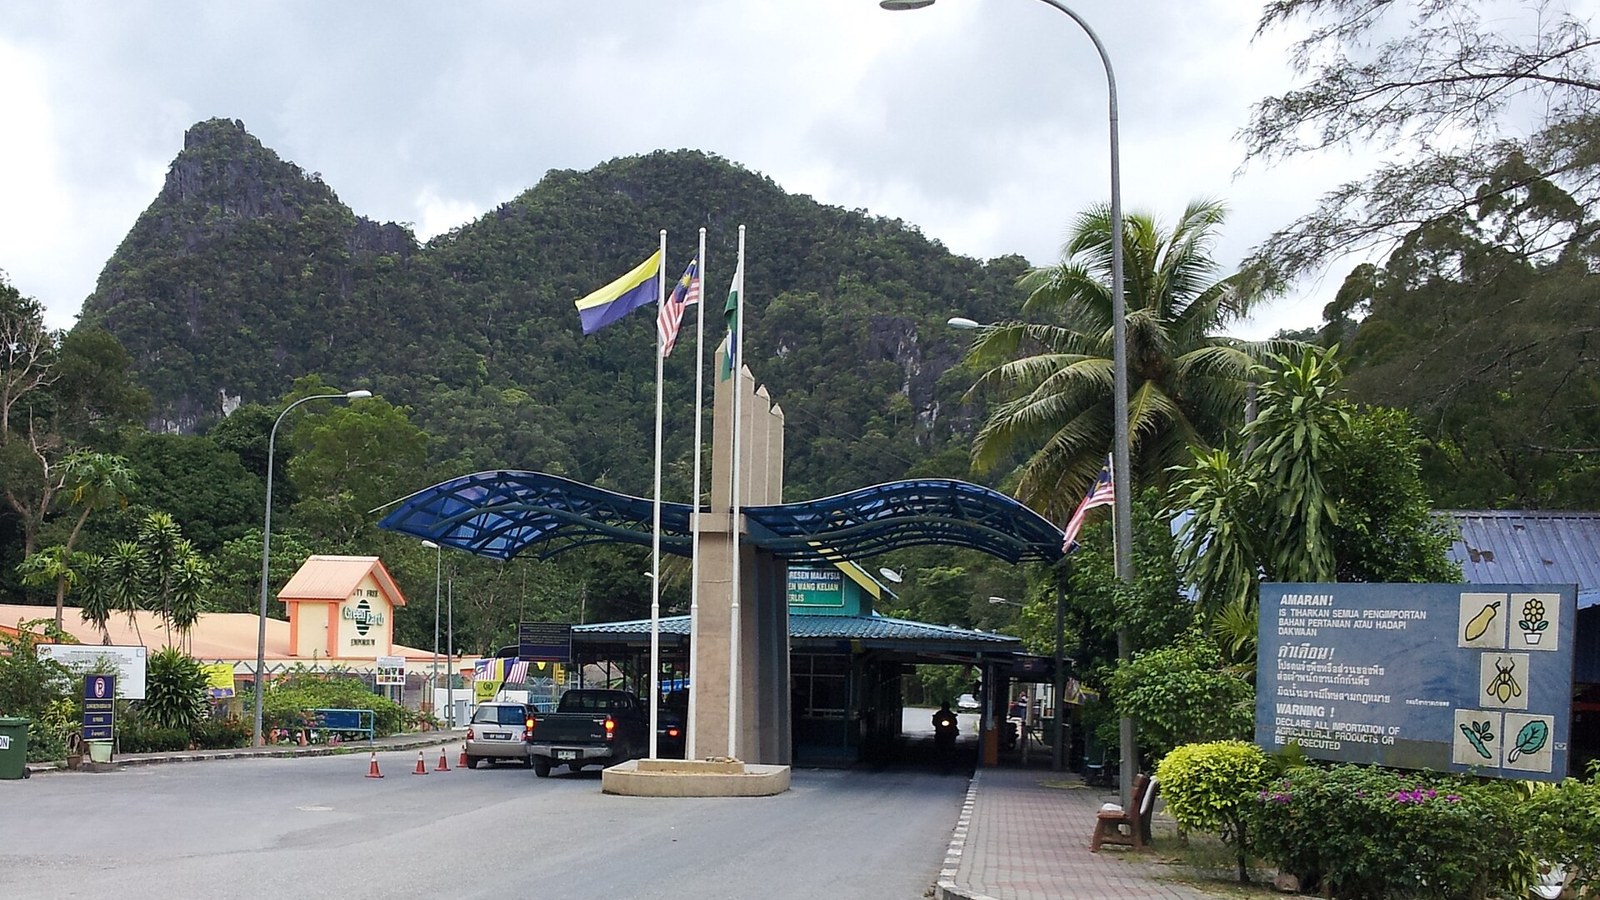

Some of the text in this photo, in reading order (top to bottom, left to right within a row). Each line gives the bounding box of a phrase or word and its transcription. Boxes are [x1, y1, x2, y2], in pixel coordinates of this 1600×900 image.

[810, 571, 841, 580] MALAYSIA
[797, 582, 816, 591] WANG
[816, 583, 839, 591] KELIAN
[1280, 594, 1333, 606] AMARAN!
[343, 606, 385, 626] Green Earth
[1290, 608, 1330, 618] TIHARKAN
[1332, 609, 1360, 619] SEMUA
[1363, 609, 1427, 620] PENGIMPORTAN
[1278, 617, 1407, 630] BAHAN PERTANIAN ATAU HADAPI
[1278, 626, 1317, 637] DAKWAAN
[1276, 703, 1335, 718] WARNING !
[1275, 717, 1401, 736] DECLARE ALL IMPORTATION OF
[1275, 735, 1286, 745] BE
[1335, 731, 1379, 745] PRODUCTS
[1381, 736, 1394, 746] OR
